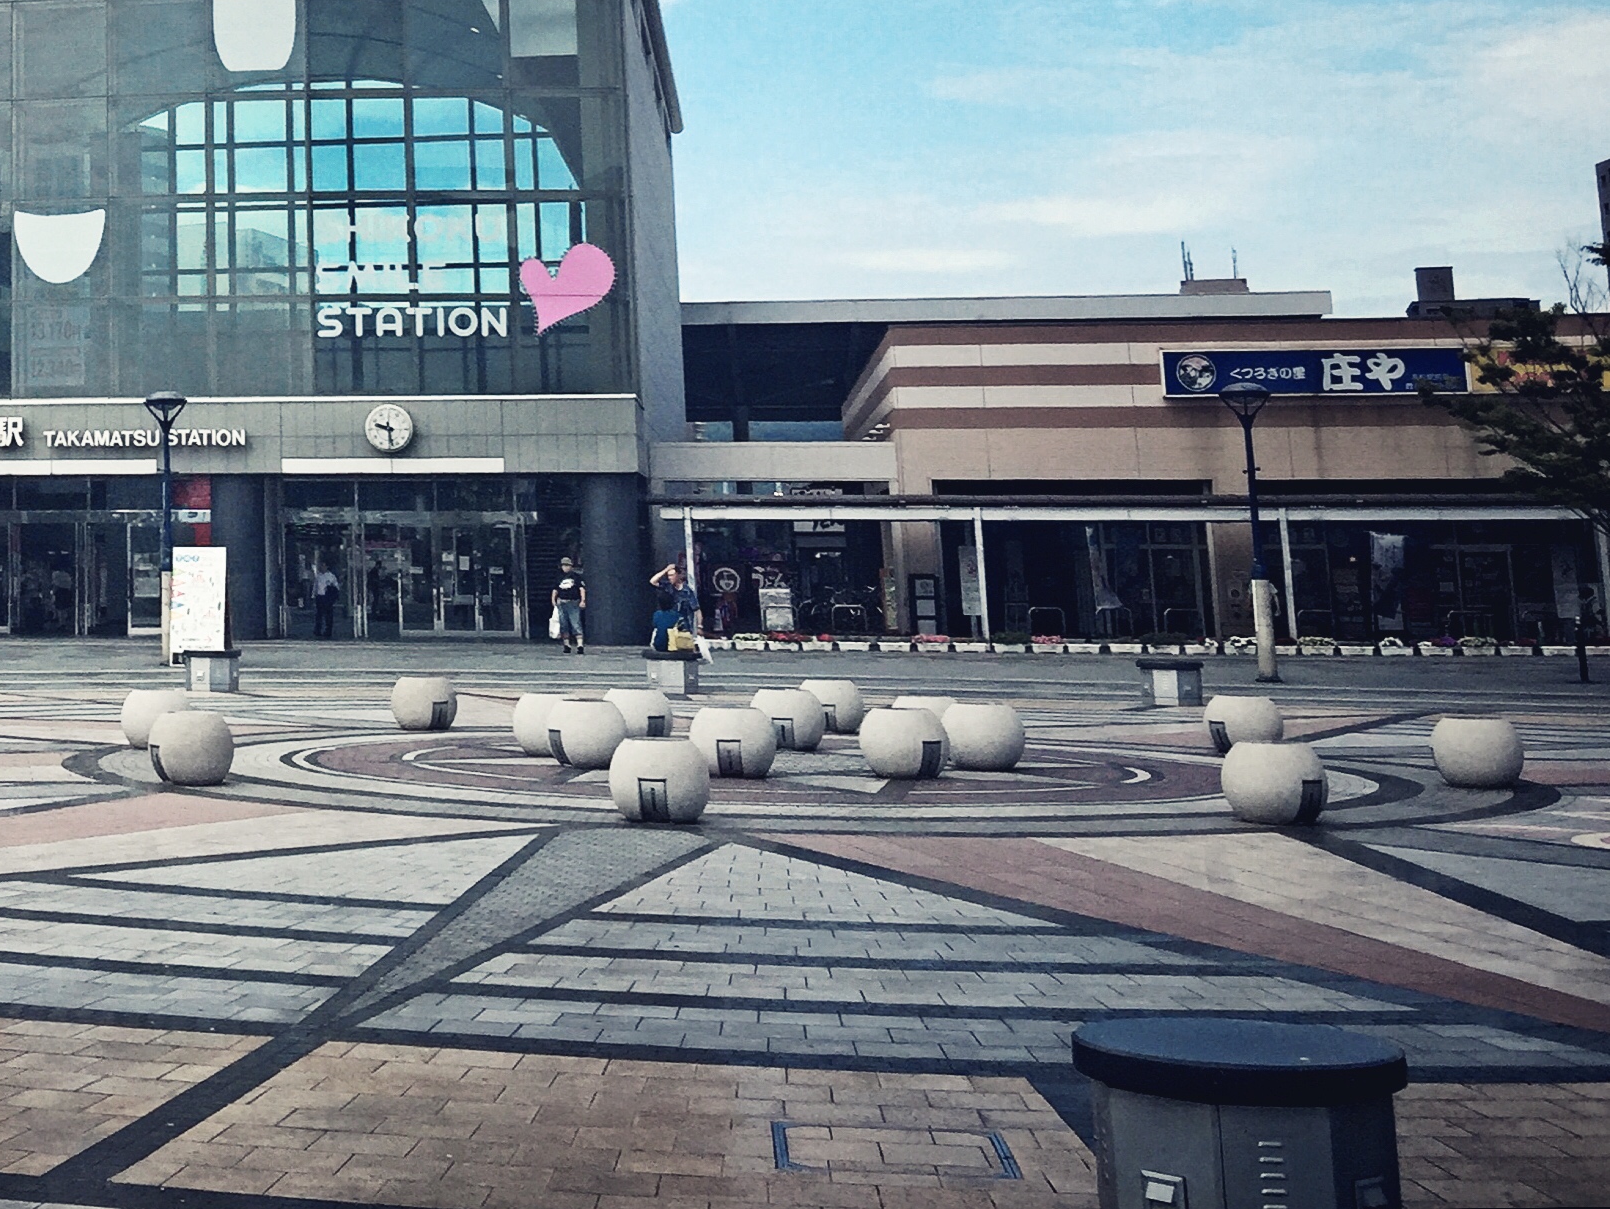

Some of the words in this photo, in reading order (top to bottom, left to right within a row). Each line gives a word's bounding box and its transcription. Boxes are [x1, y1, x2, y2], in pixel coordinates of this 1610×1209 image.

[316, 307, 508, 338] STATION
[1321, 353, 1406, 391] 庄や
[43, 429, 160, 447] TAKAMATSU
[167, 428, 246, 446] STATION
